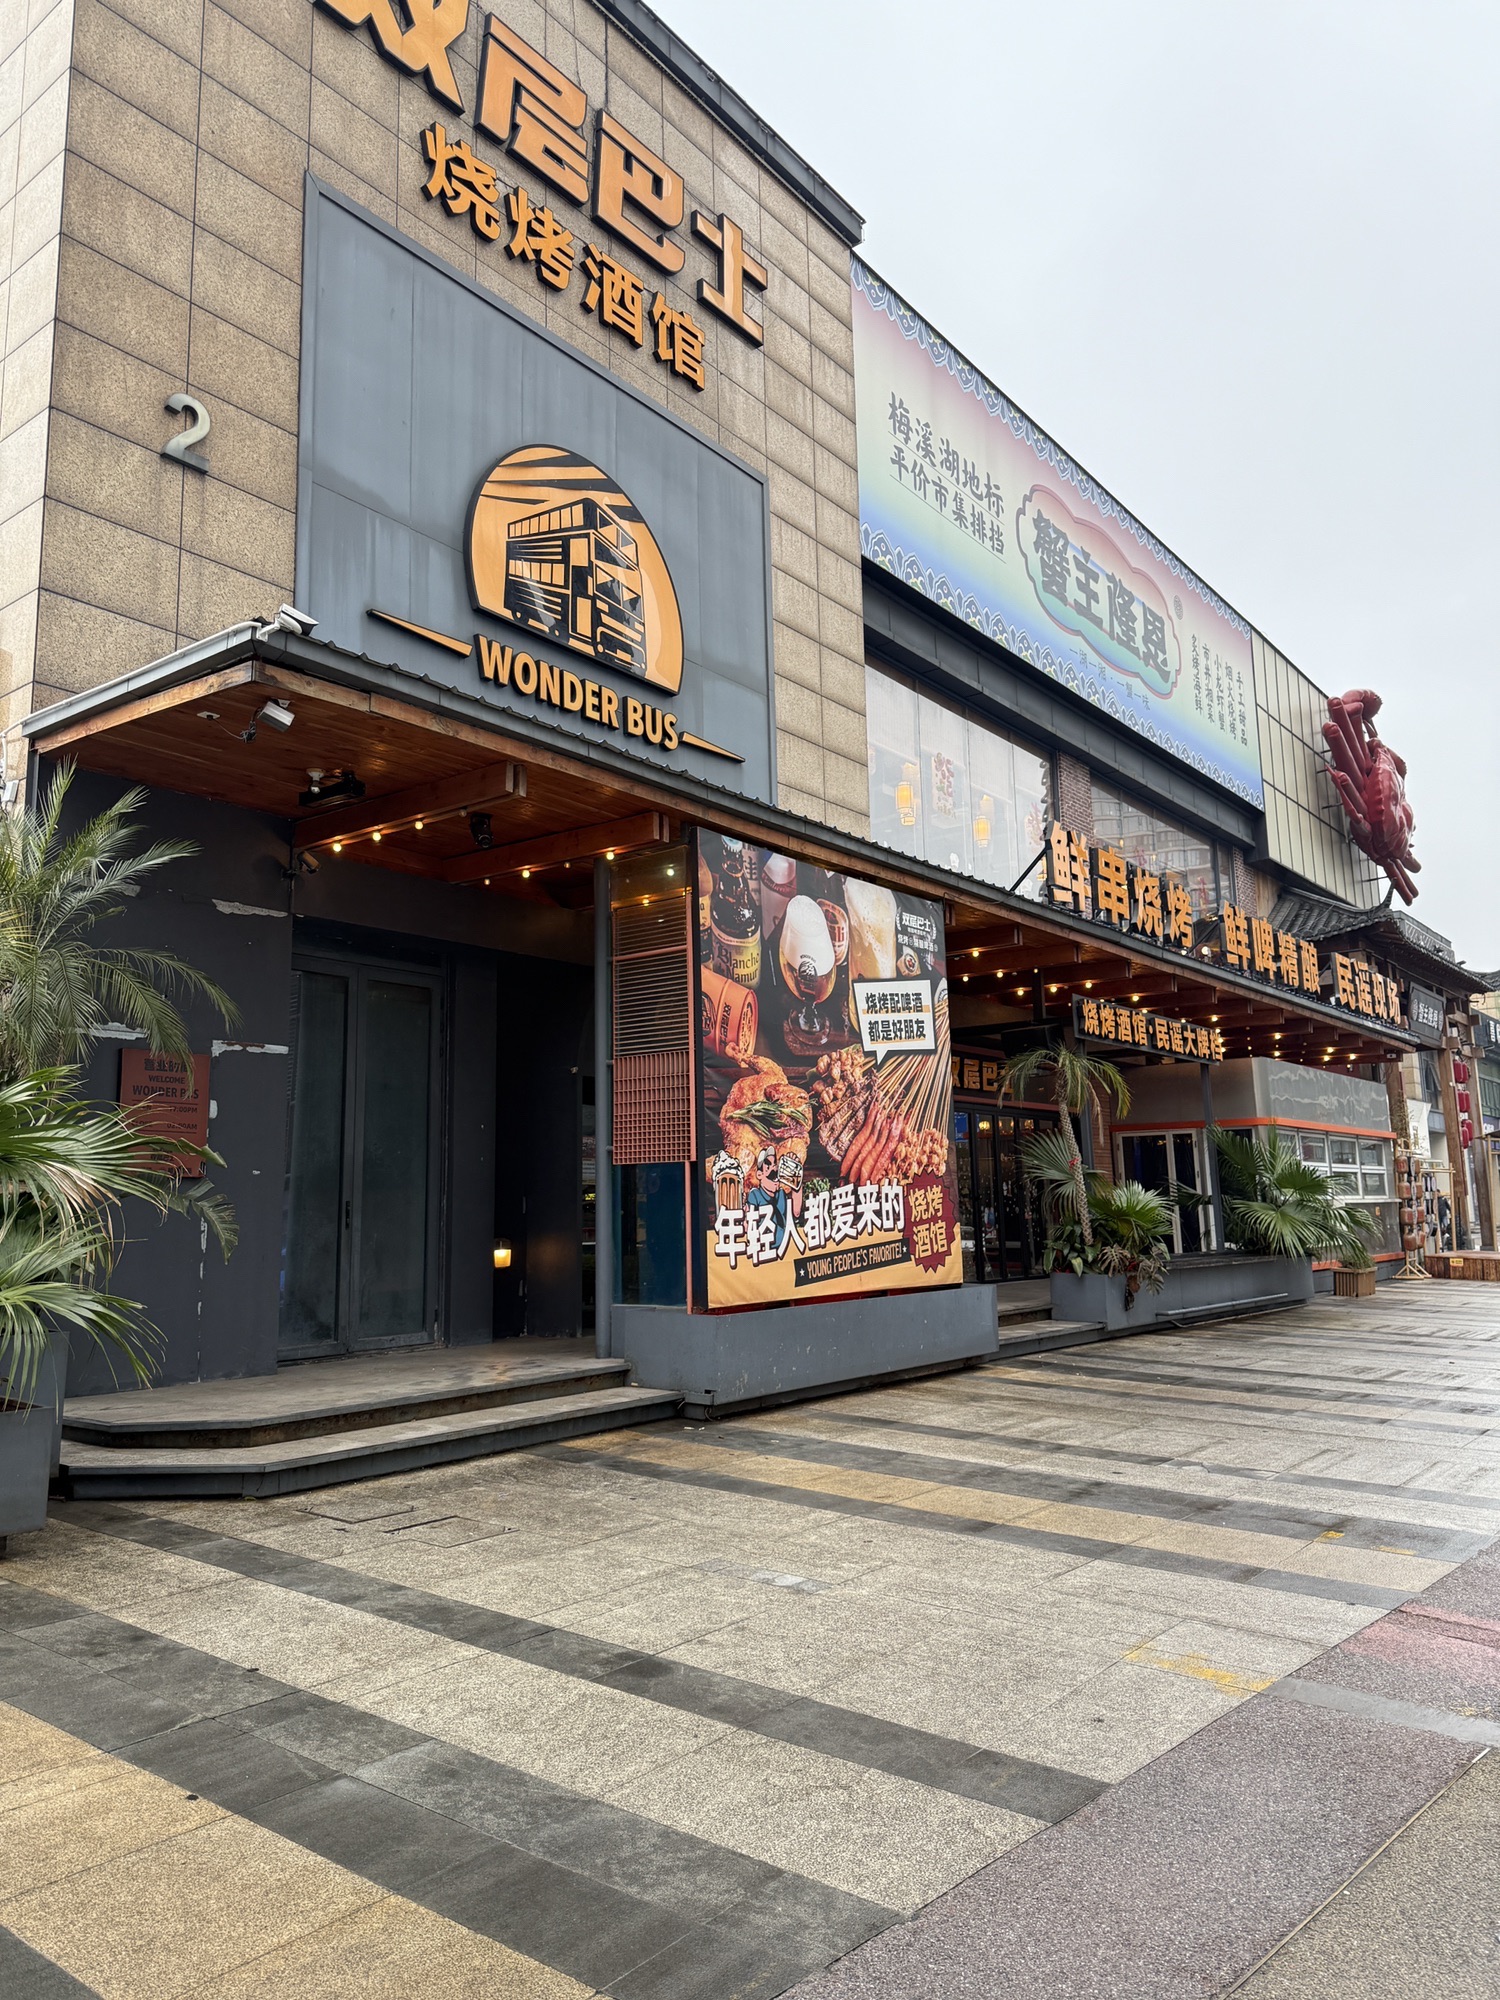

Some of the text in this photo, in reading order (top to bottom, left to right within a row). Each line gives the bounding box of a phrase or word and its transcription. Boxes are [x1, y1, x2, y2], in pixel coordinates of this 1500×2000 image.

[419, 121, 705, 391] 烧烤酒馆
[161, 392, 211, 474] 2
[888, 391, 1005, 518] 梅溪湖地标
[889, 444, 1005, 554] 平价市集排挡
[474, 634, 679, 751] WONDER BUS
[902, 912, 930, 931] 双层巴士
[1047, 821, 1401, 1025] 鲜串烧烤 鲜啤精酿 民谣现场
[865, 992, 924, 1015] 烧烤配啤酒
[868, 1018, 926, 1042] 都是好朋友
[148, 1074, 186, 1085] WELCOME
[180, 1089, 199, 1099] BS
[909, 1184, 943, 1222] 烧烤
[715, 1178, 905, 1269] 年轻人都爱来的
[912, 1220, 948, 1259] 酒馆
[807, 1242, 903, 1279] YOUNG PEOPLE'S FAVORITE!
